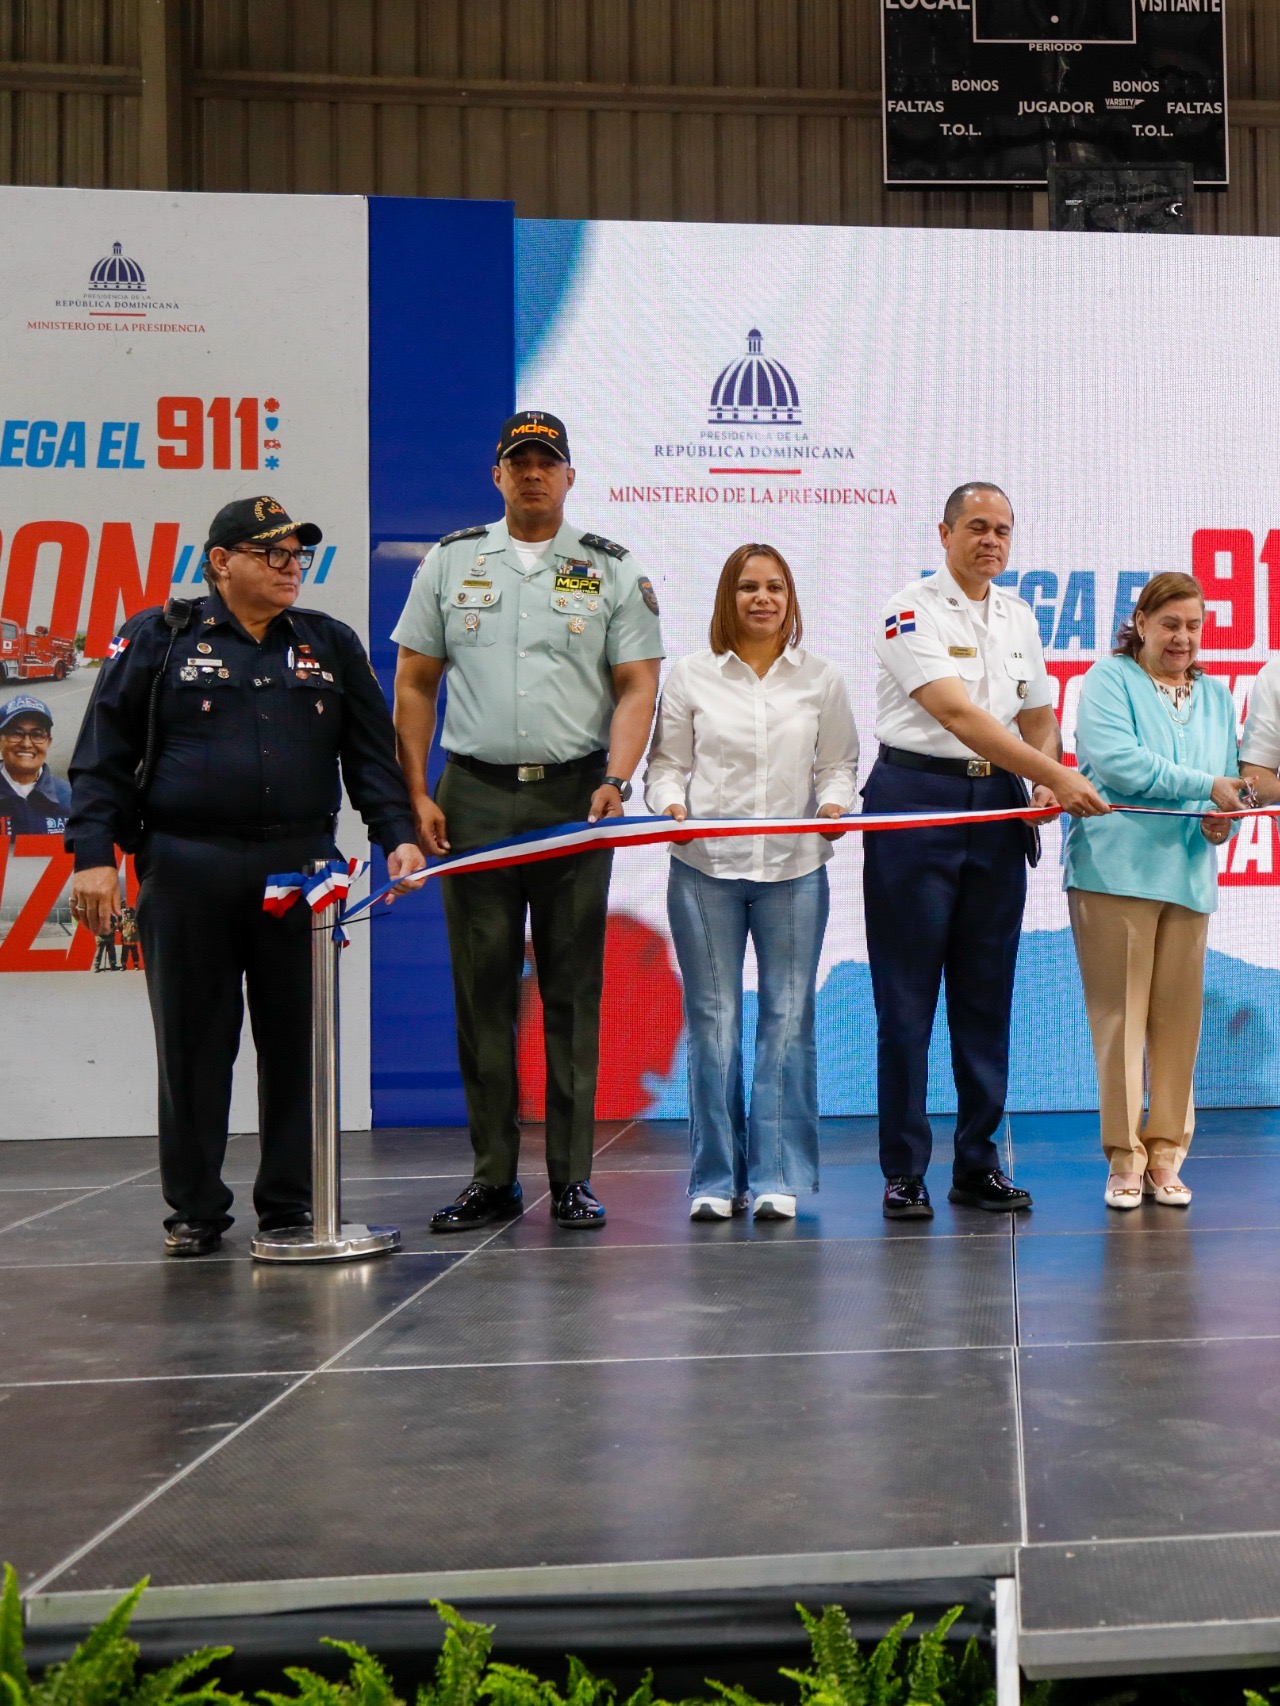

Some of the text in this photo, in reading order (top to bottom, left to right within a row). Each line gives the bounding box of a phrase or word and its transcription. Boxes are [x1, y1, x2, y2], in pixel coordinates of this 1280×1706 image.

[885, 0, 971, 10] LOCAL
[1139, 0, 1221, 12] VISITANTE
[1028, 42, 1083, 52] PERIODO
[951, 79, 999, 92] BONOS
[1112, 80, 1160, 93] BONOS
[887, 100, 945, 113] FALTAS
[1018, 101, 1095, 116] JUGADOR
[1104, 98, 1136, 106] VARSITY
[1166, 102, 1223, 115] FALTAS
[939, 123, 982, 137] T.O.L.
[1131, 124, 1174, 138] T.O.L.
[55, 299, 180, 309] REPÚBLICA DOMINICANA
[27, 321, 206, 333] MINISTERIO DE LA PRESIDENCIA
[96, 421, 146, 469] EL
[157, 396, 259, 470] 911
[510, 423, 560, 439] MOPC
[699, 431, 809, 442] PRESIDENCIA DE LA
[654, 442, 856, 460] REPÚBLICA DOMINICANA
[608, 486, 898, 506] MINISTERIO DE LA PRESIDENCIA
[0, 520, 180, 658] ON
[557, 577, 600, 590] MOPC
